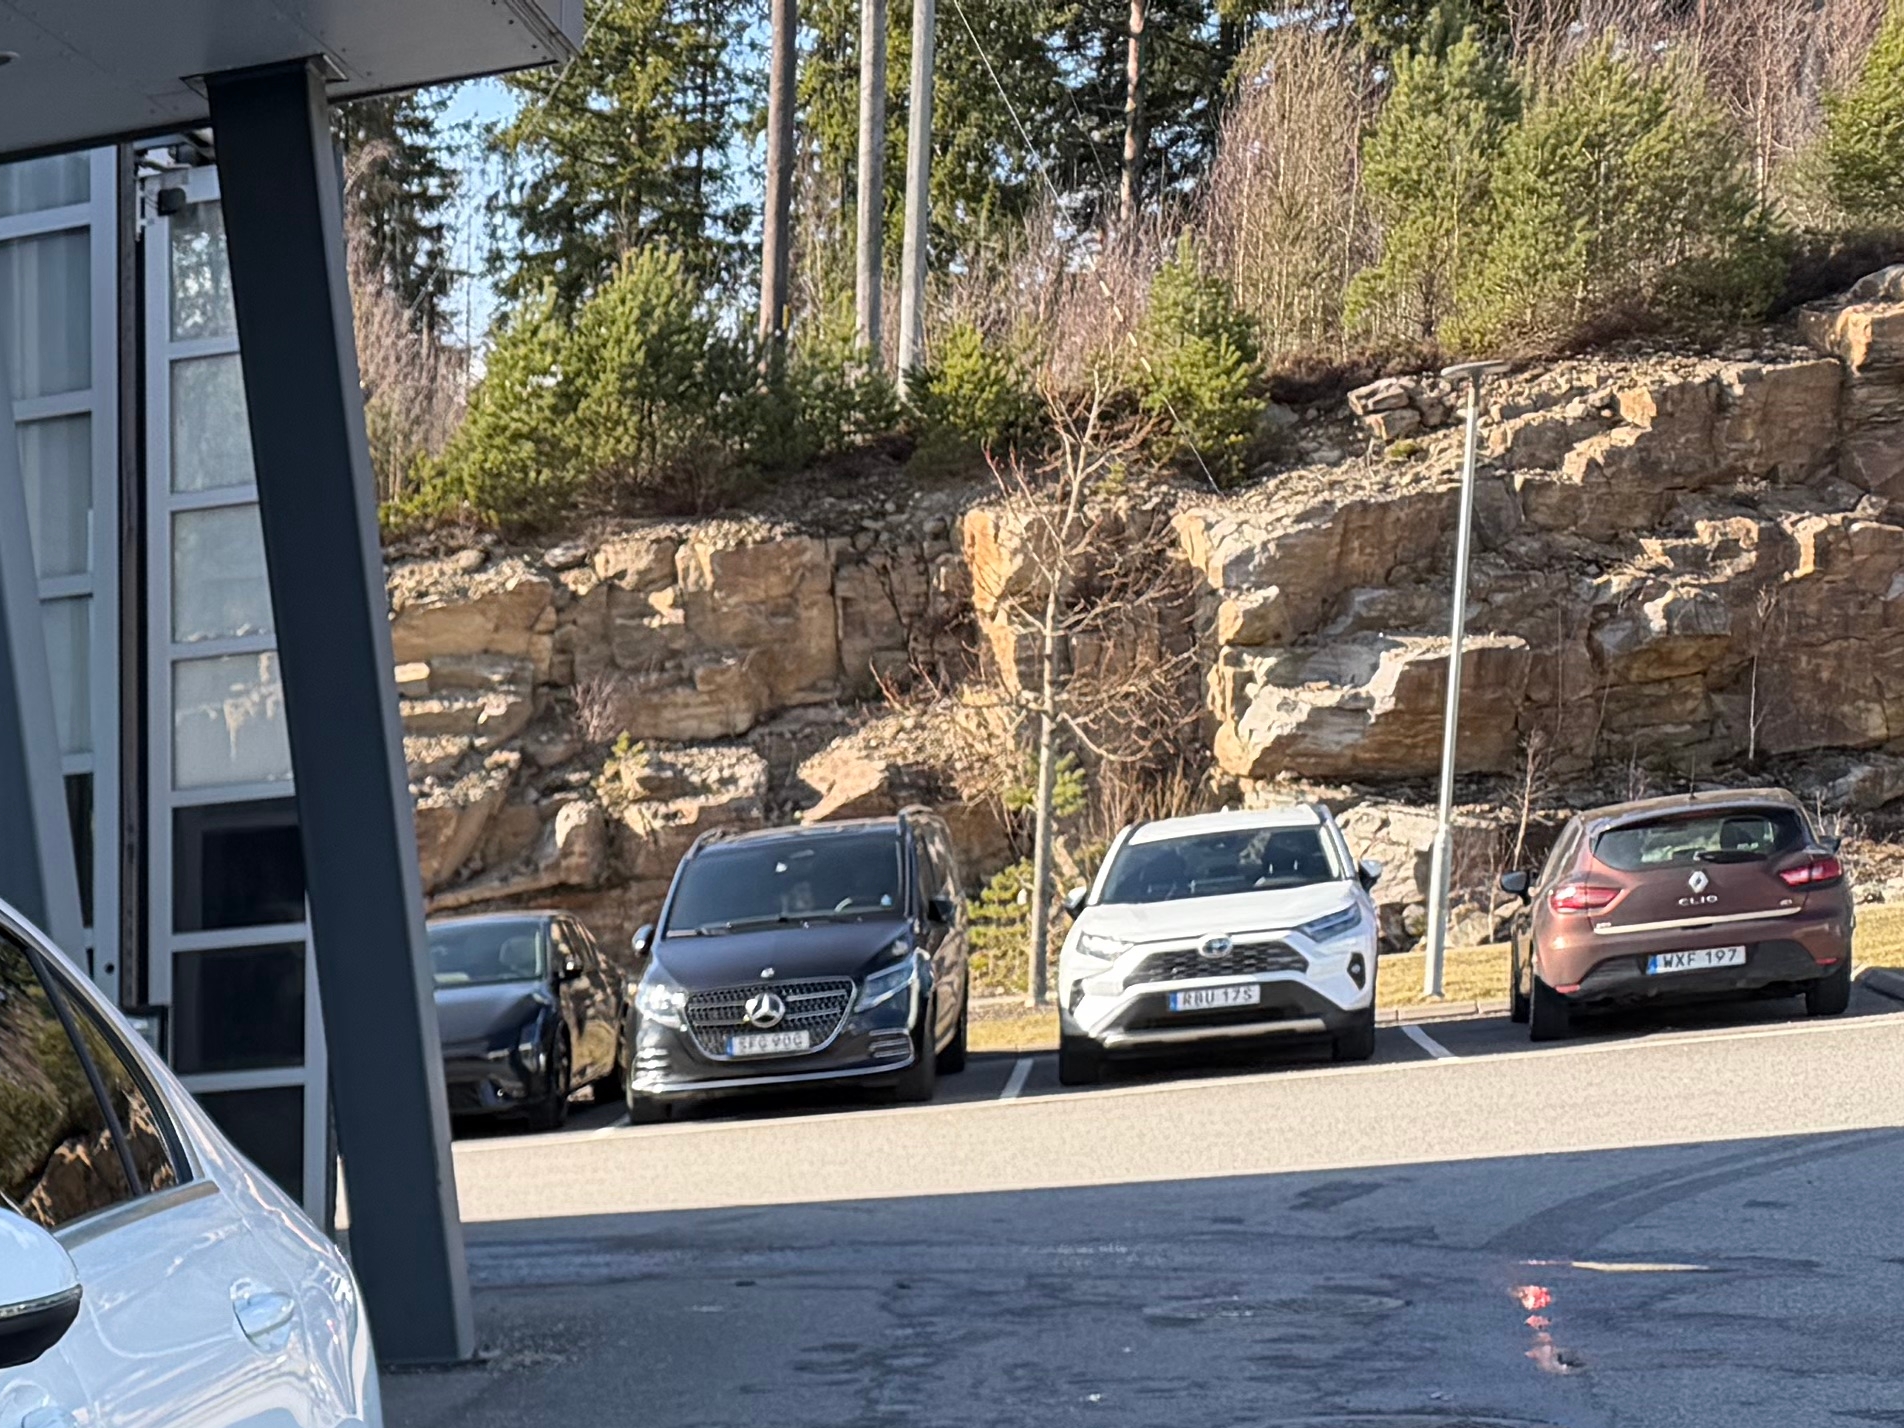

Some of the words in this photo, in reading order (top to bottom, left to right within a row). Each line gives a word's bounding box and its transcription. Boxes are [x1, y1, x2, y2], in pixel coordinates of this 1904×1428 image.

[1678, 895, 1718, 906] CLIO
[1663, 951, 1696, 968] WXF
[1705, 948, 1737, 964] 197
